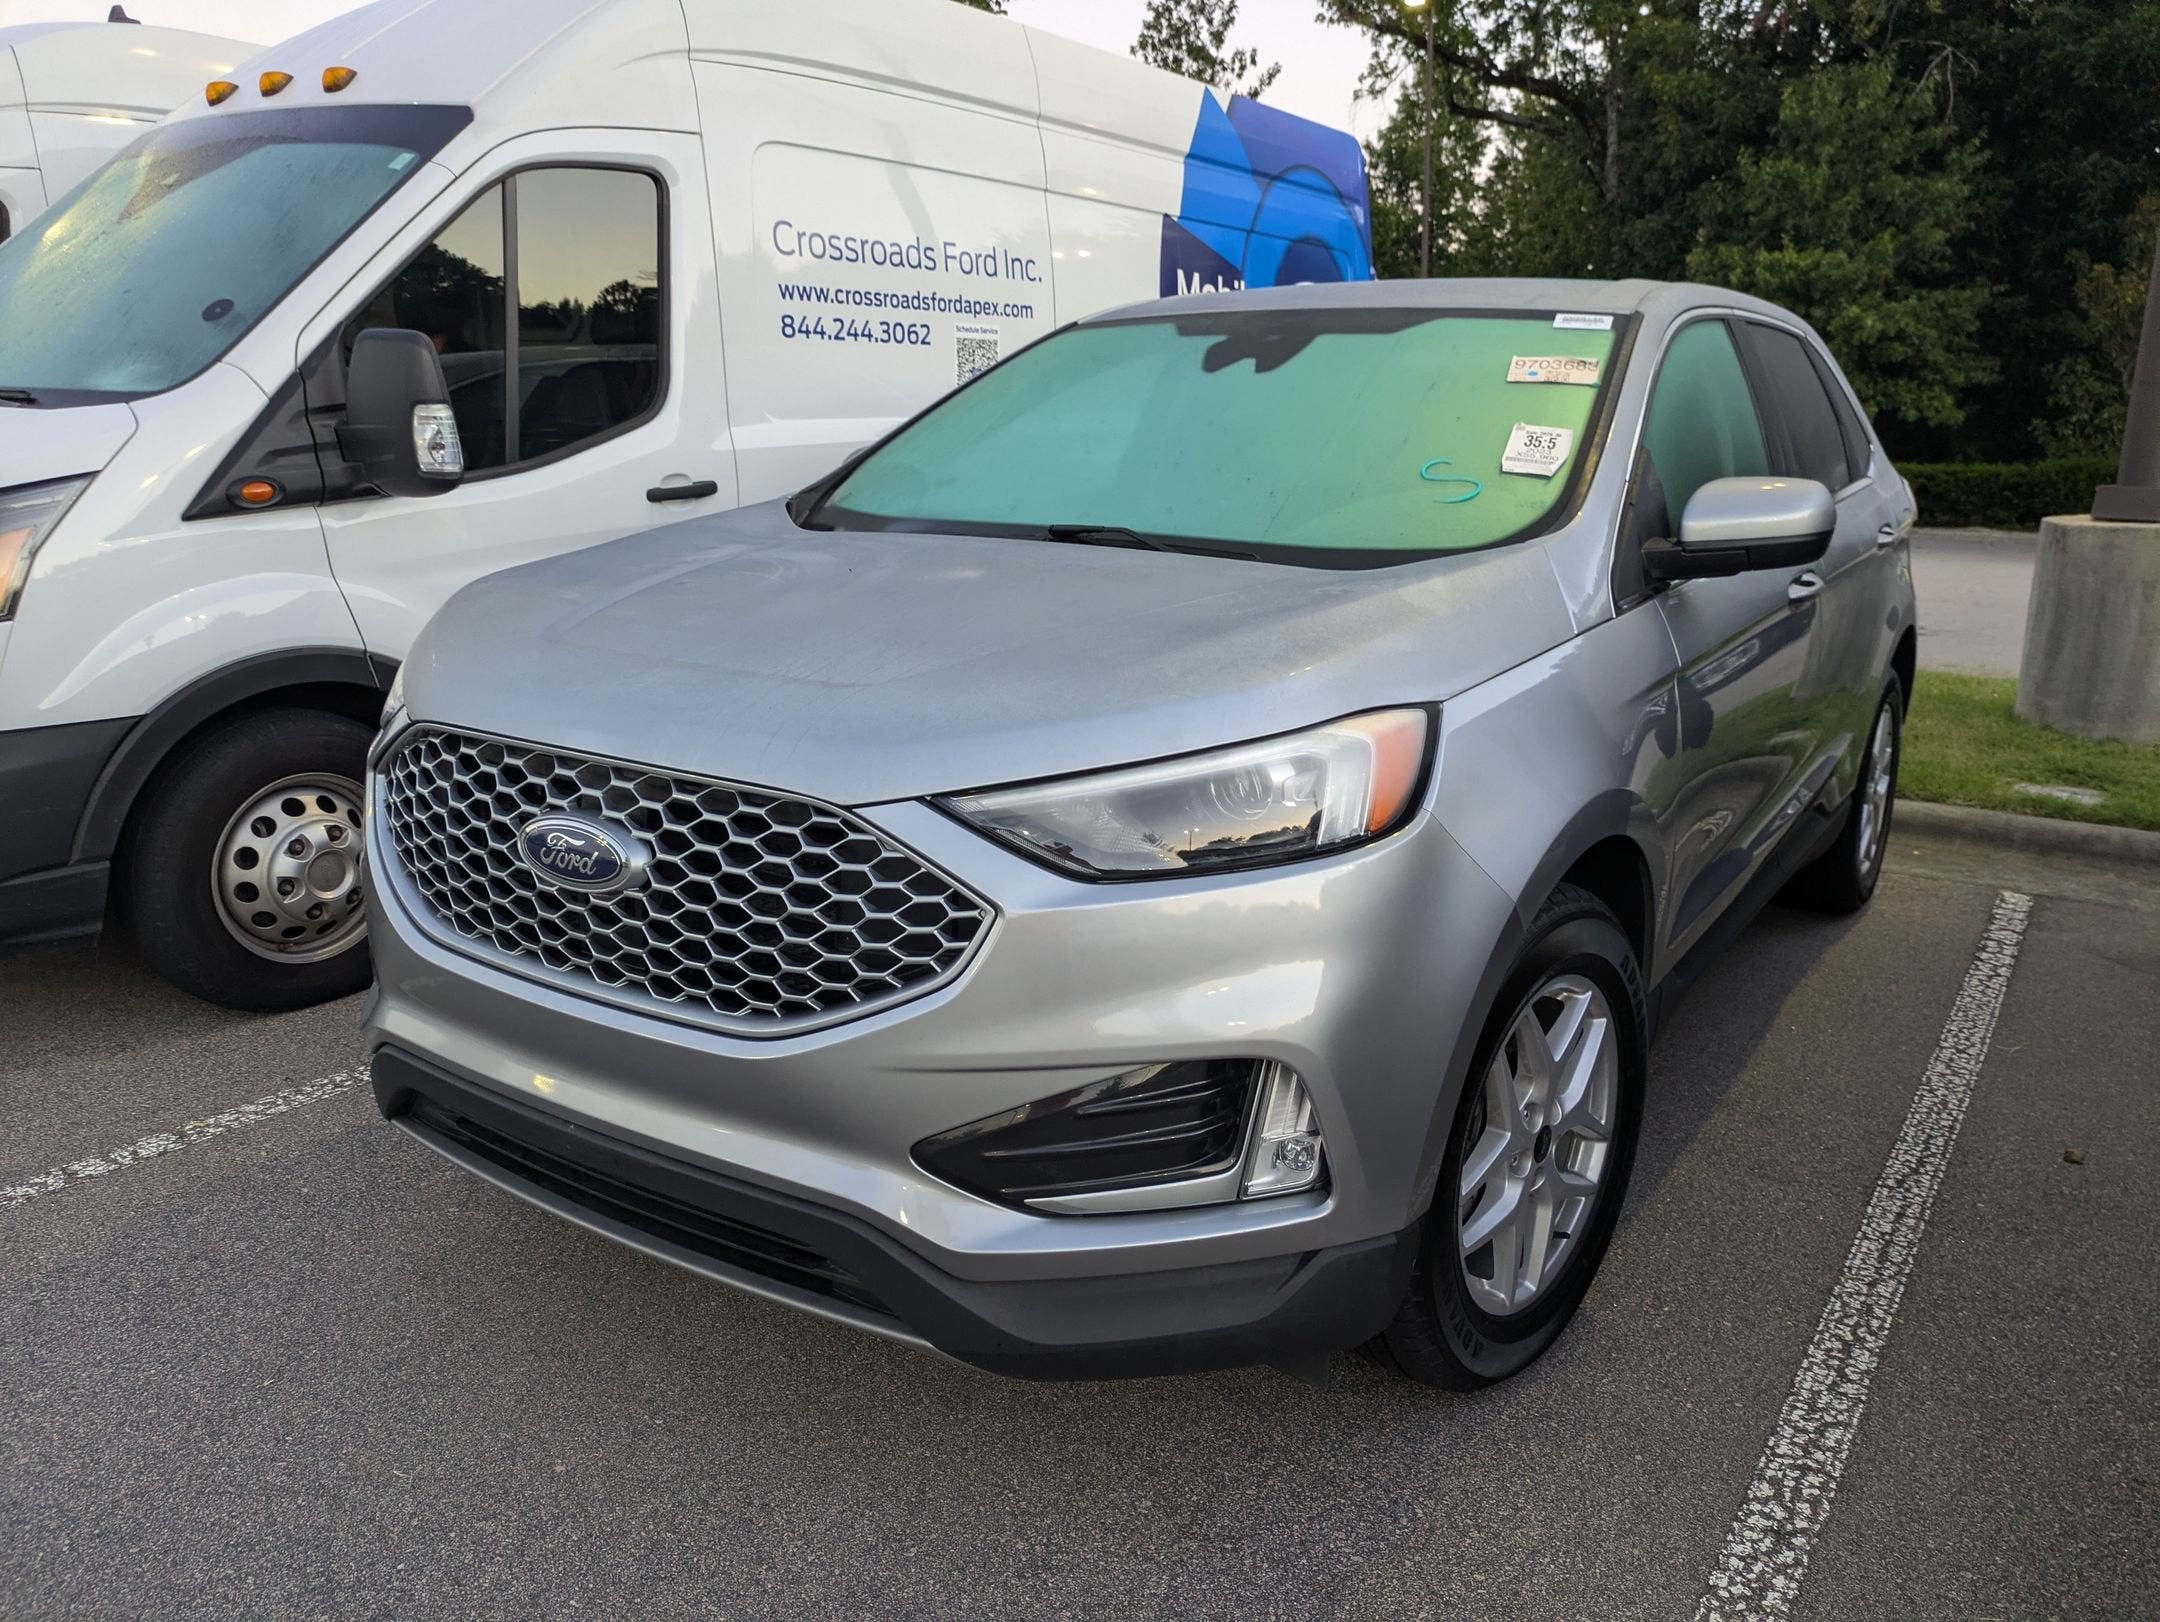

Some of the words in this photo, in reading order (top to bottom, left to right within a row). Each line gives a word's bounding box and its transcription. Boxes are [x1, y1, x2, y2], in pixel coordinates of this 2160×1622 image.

[772, 219, 938, 271] Crossroads
[943, 240, 997, 278] Ford
[1004, 248, 1042, 283] Inc.
[778, 283, 1034, 319] www.crossroadsfordapex.com
[781, 314, 932, 346] 844.244.3062
[955, 325, 979, 334] Schedule
[980, 326, 998, 335] Service
[1524, 434, 1557, 450] 35:5
[1419, 457, 1484, 505] S
[540, 832, 599, 876] Ford
